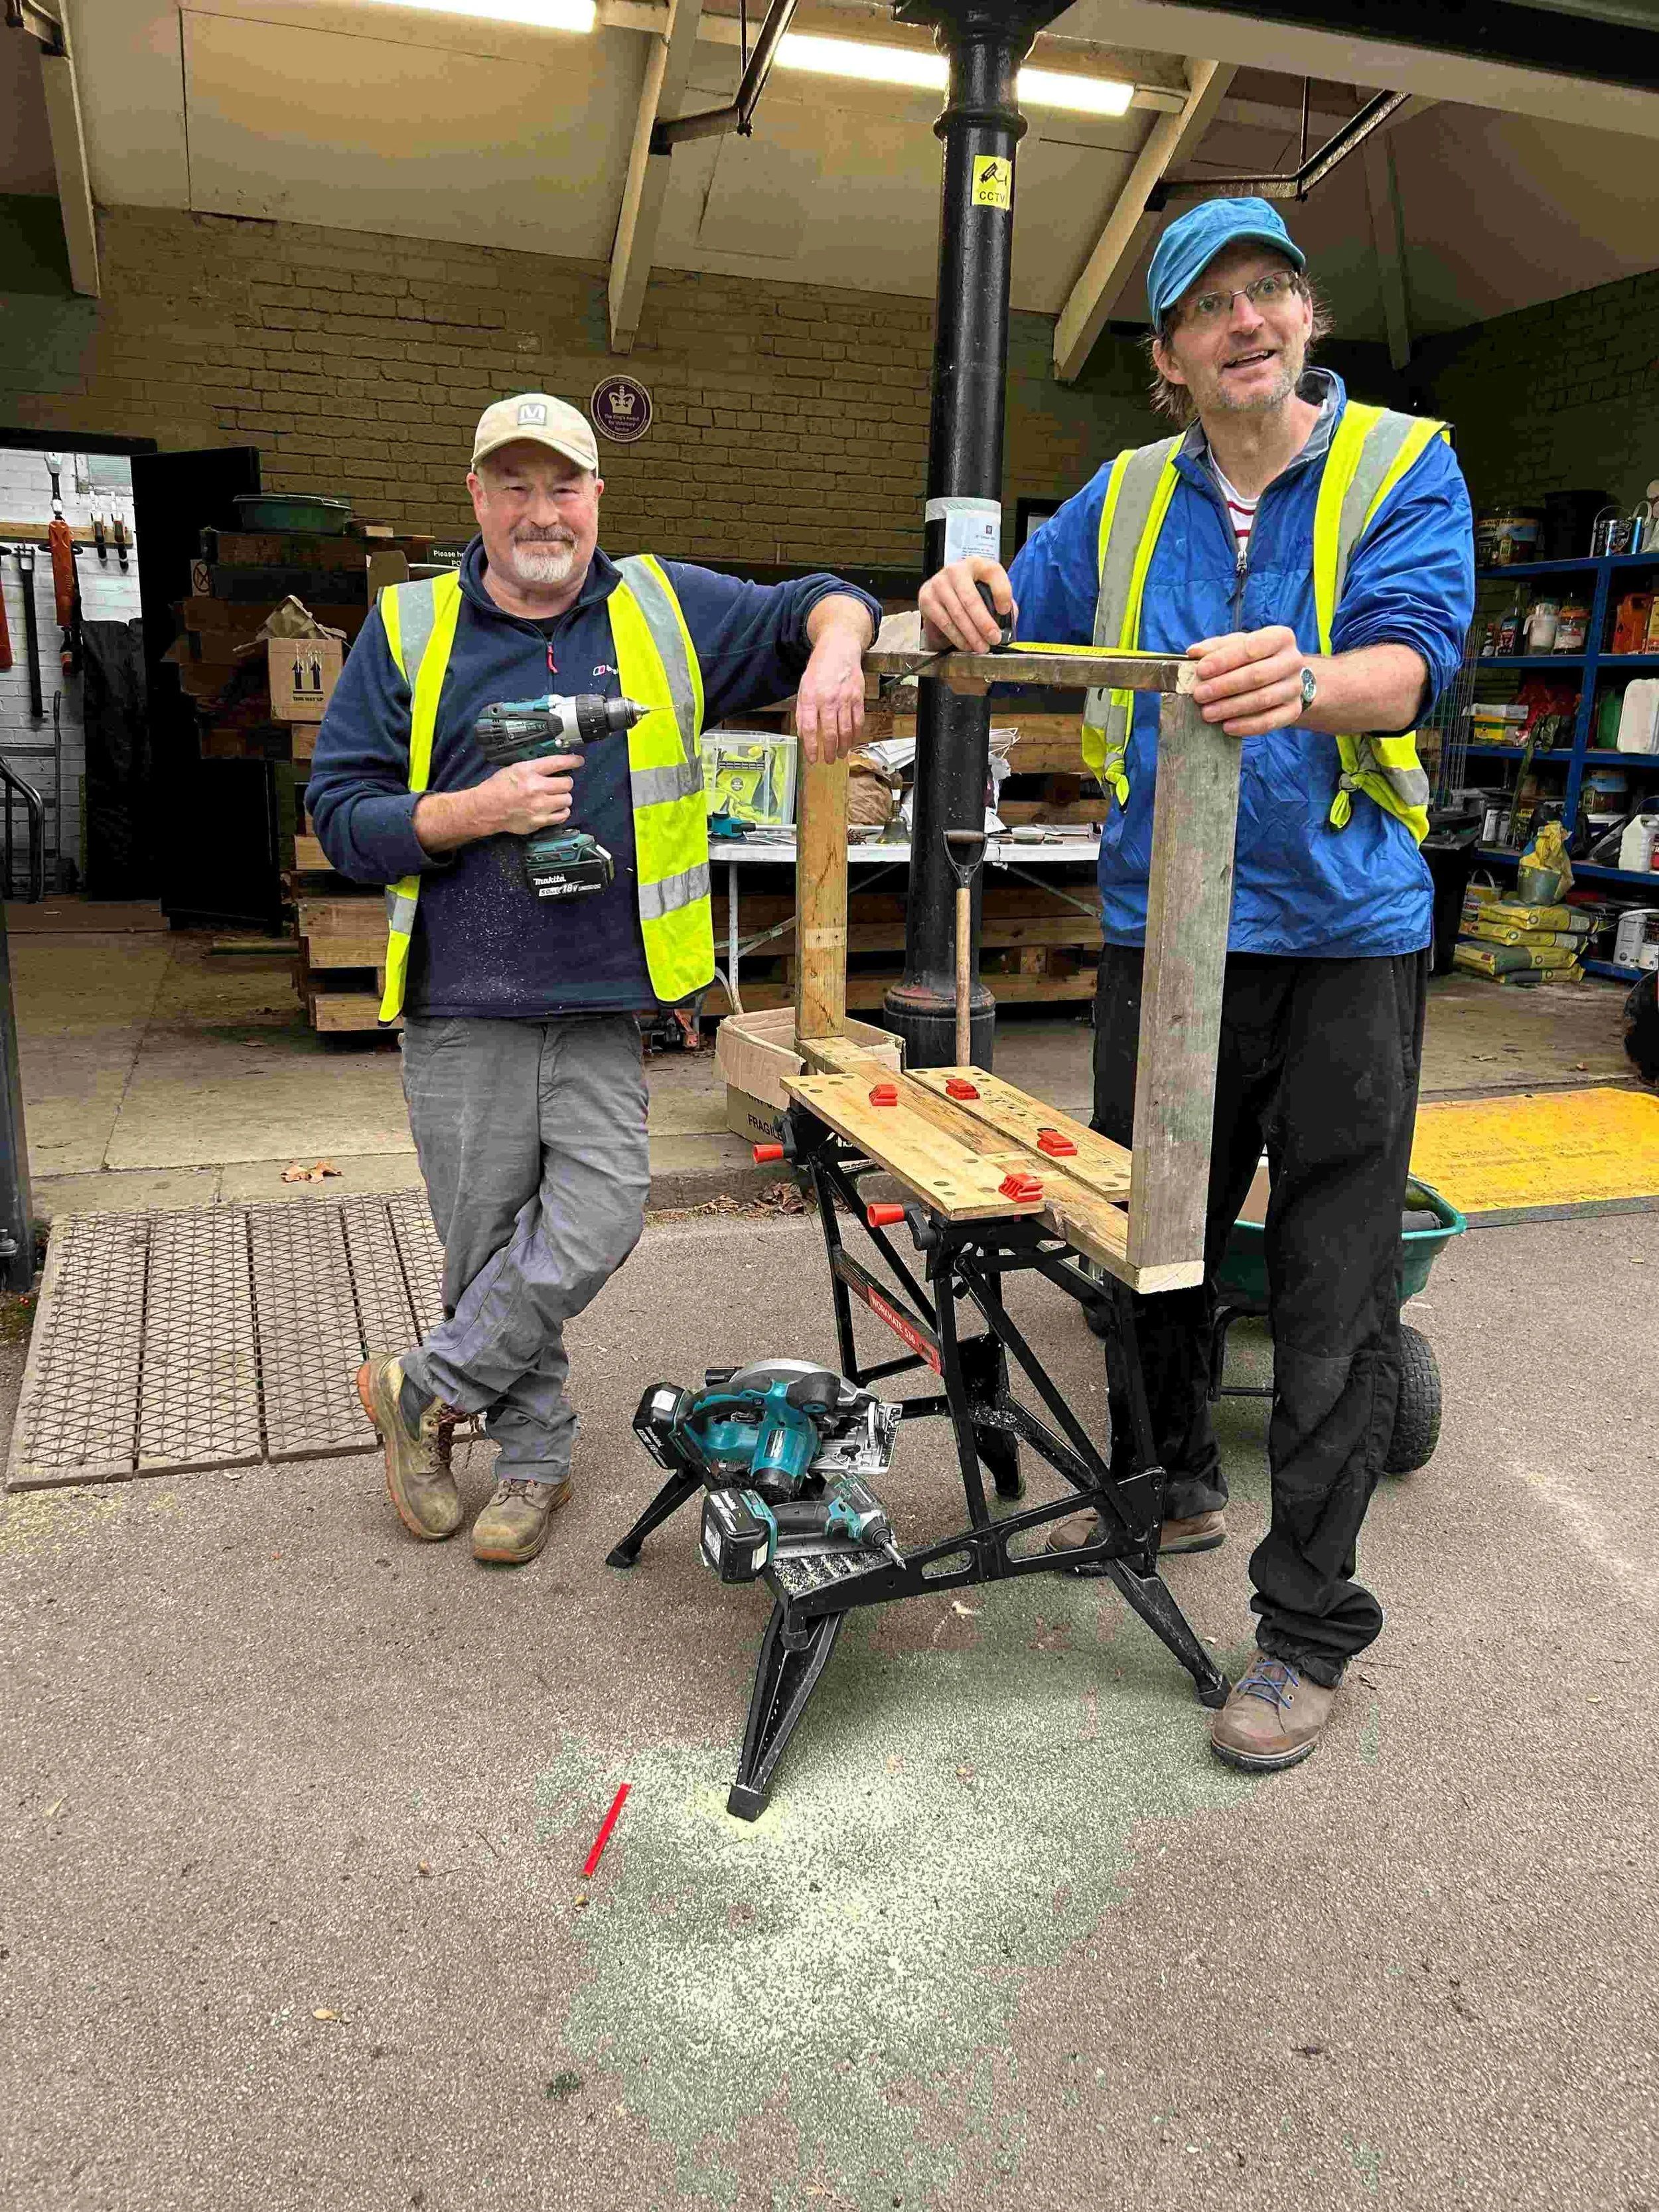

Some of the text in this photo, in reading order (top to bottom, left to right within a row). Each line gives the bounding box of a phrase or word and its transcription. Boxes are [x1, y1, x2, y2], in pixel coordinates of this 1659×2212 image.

[979, 190, 1005, 203] CCTV
[747, 1113, 782, 1142] FRAGILE
[870, 1294, 904, 1333] WORKMATE
